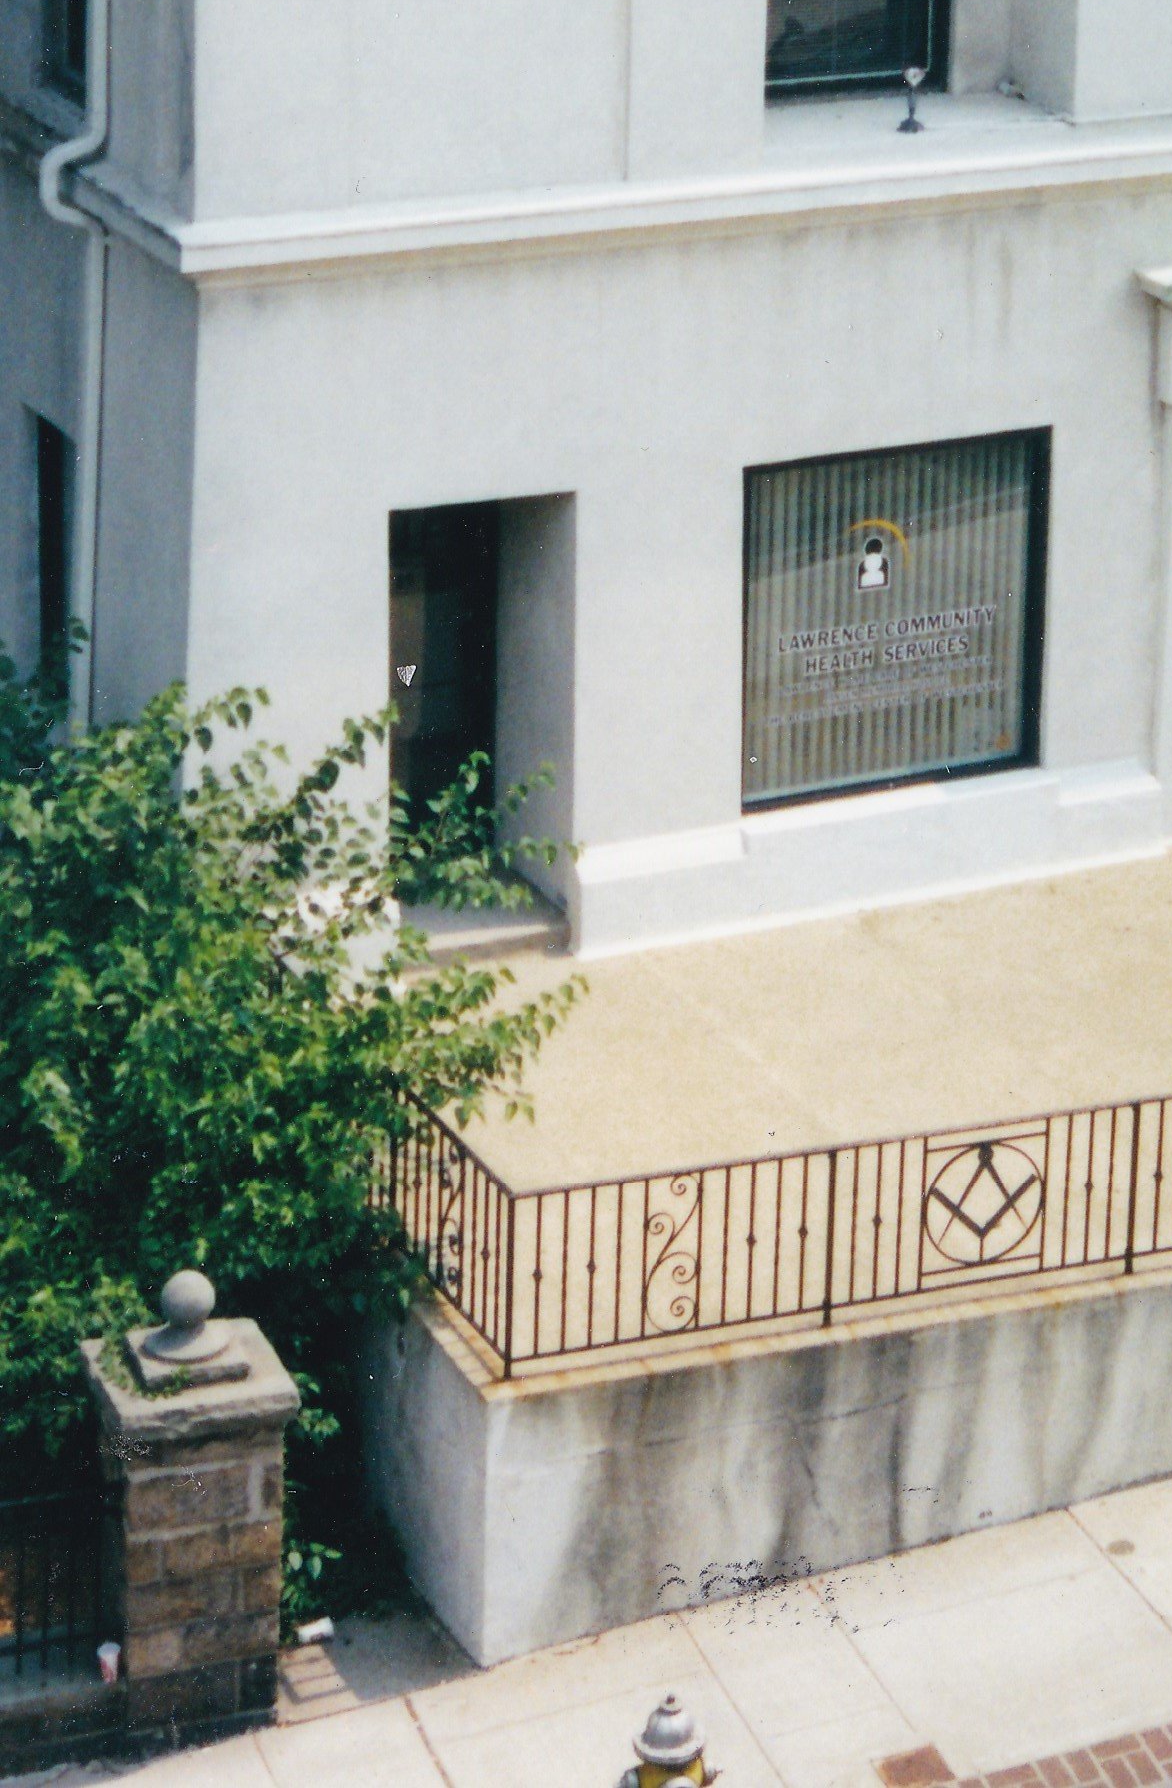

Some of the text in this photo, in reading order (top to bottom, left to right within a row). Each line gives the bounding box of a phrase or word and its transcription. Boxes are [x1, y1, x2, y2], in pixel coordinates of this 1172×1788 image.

[778, 606, 996, 652] LAWRENCE COMMUNITY
[805, 635, 969, 673] HEALTH SERVICES
